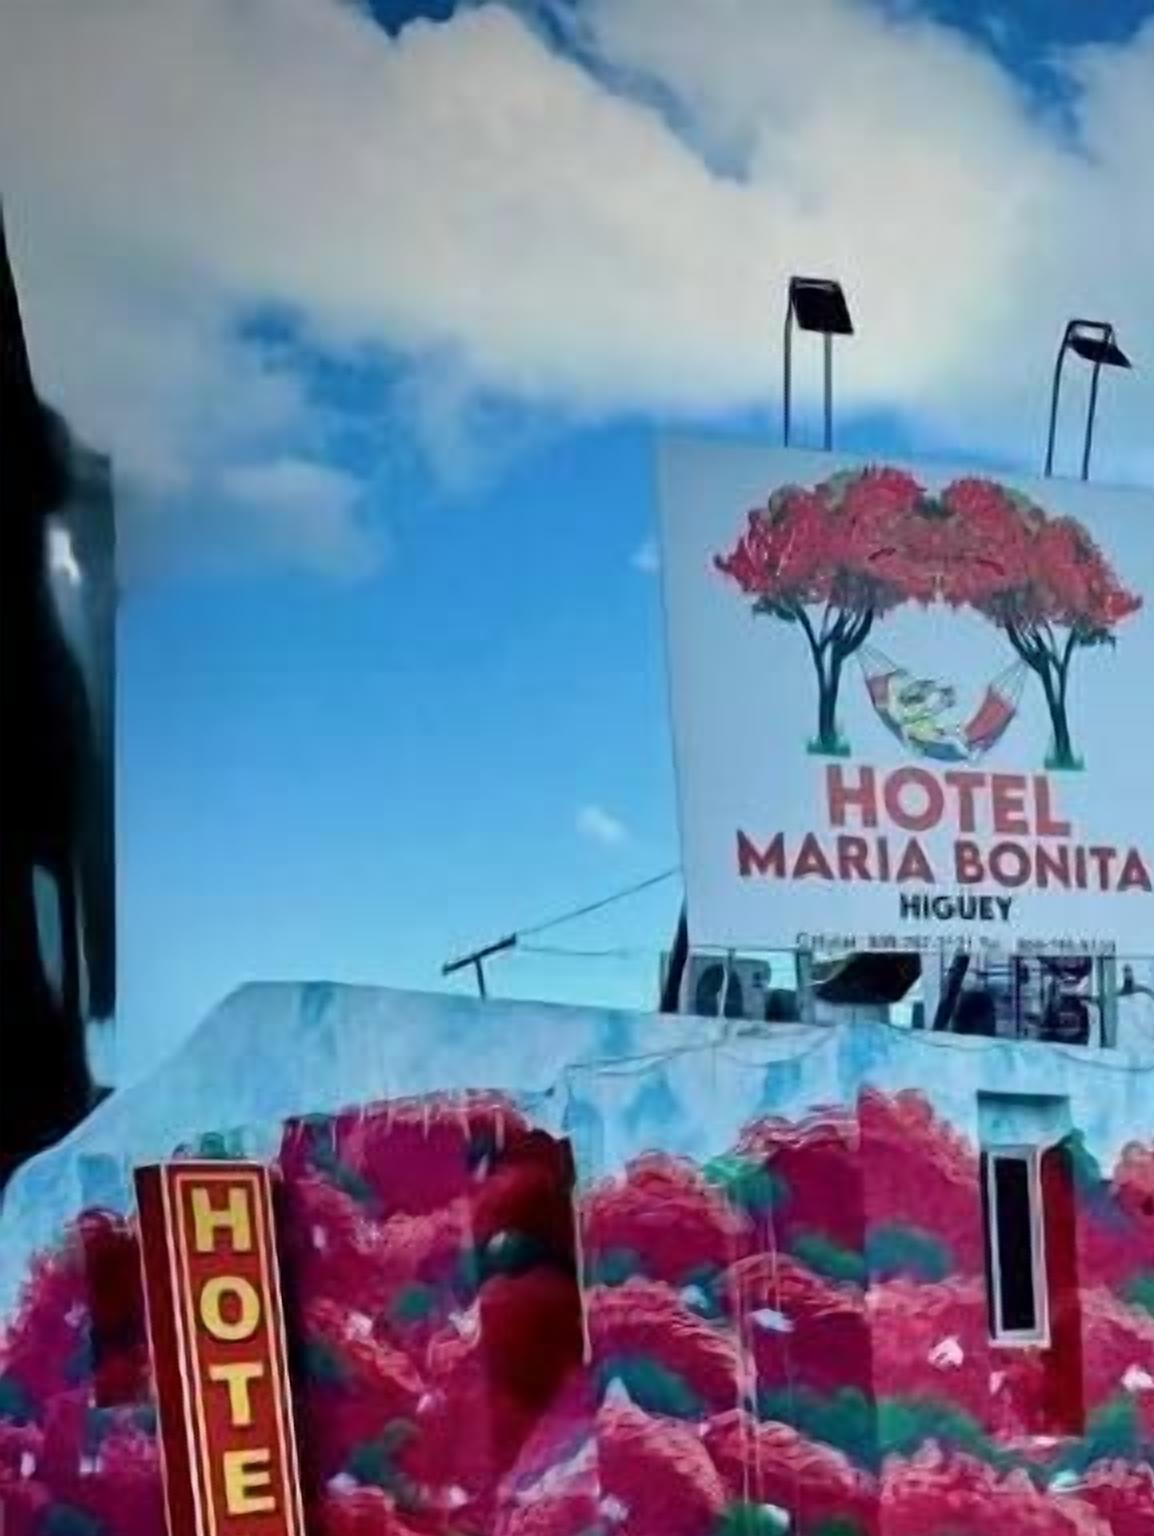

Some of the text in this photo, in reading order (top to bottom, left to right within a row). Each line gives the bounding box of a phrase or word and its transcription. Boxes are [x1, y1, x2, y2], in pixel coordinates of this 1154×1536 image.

[825, 764, 1071, 837] HOTEL
[736, 830, 1153, 892] MARIA BONITA
[899, 893, 1014, 921] HIGUEY
